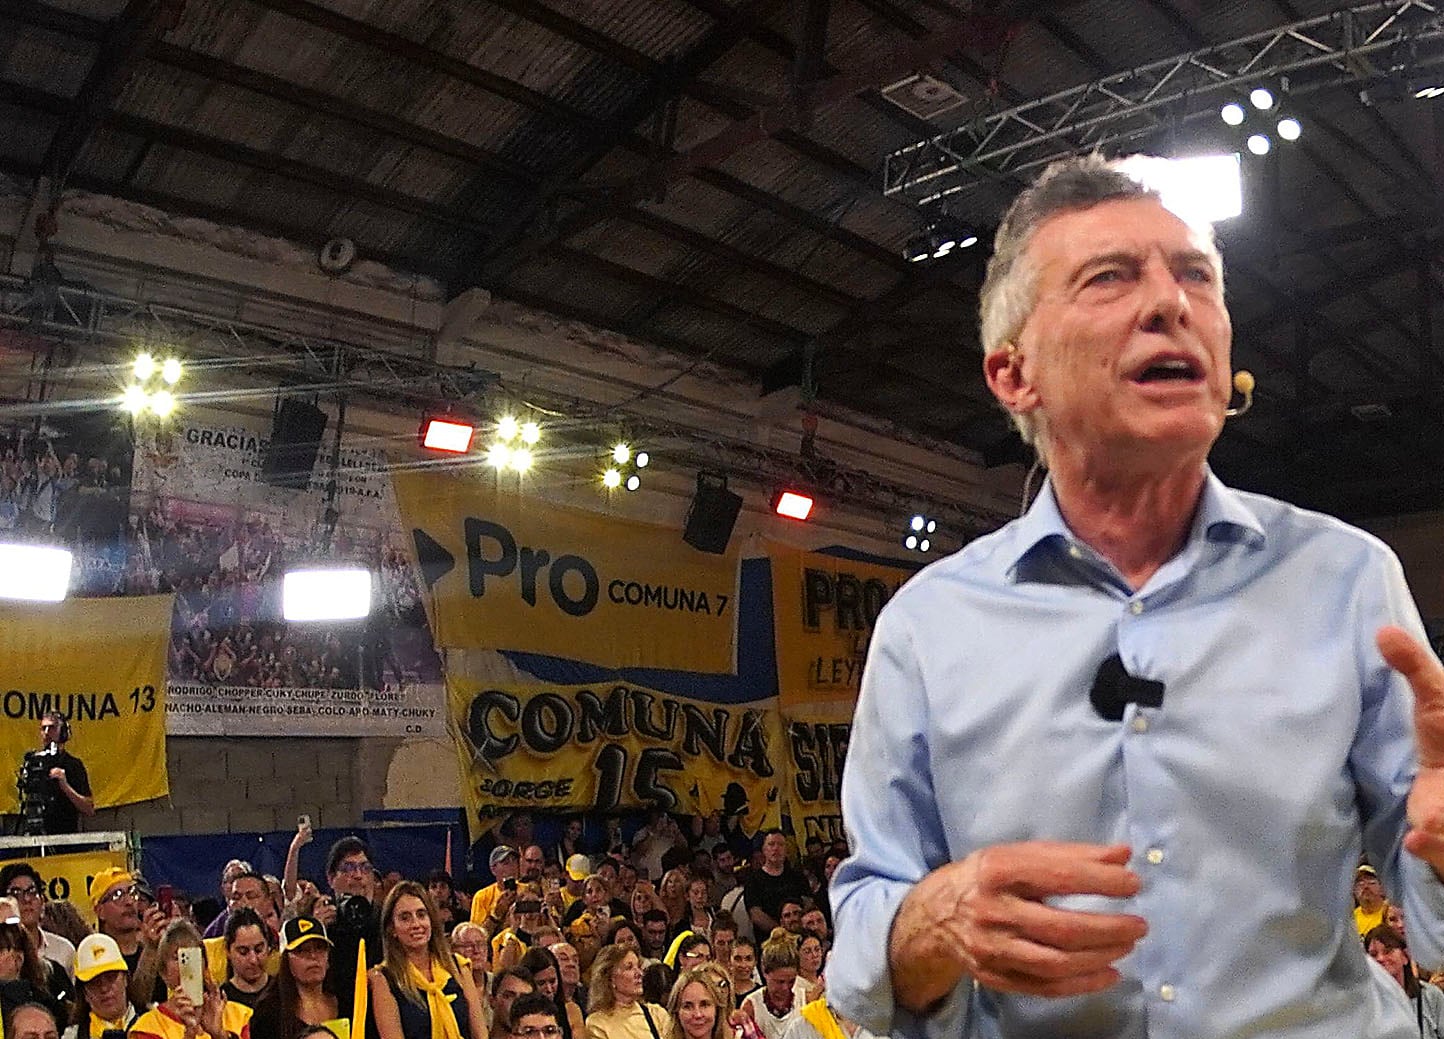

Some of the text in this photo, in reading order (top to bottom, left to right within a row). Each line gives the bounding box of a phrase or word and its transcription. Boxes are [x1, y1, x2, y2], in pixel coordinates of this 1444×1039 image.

[465, 517, 728, 617] Pro COMUNA 7
[0, 685, 156, 720] OMUNA 13
[468, 687, 774, 777] COMUNA
[595, 744, 685, 811] 15
